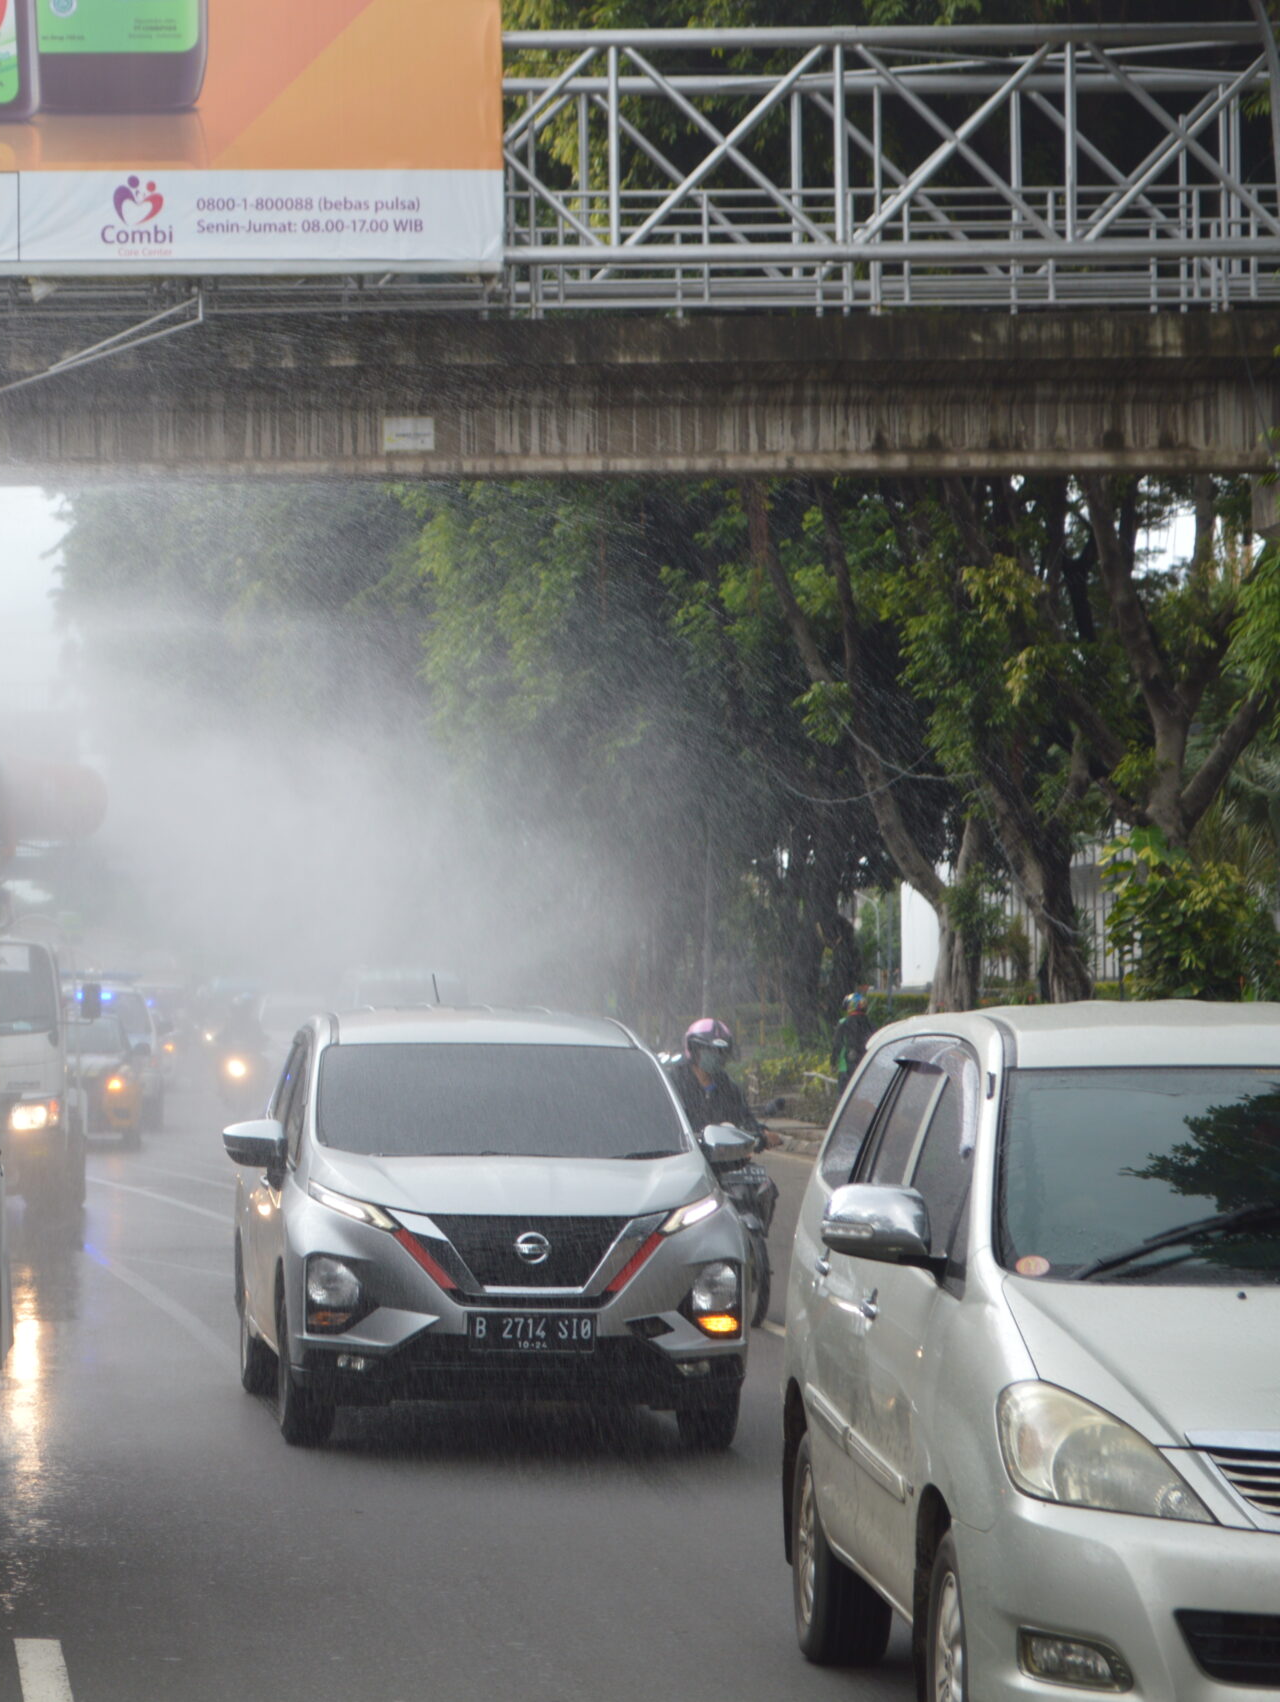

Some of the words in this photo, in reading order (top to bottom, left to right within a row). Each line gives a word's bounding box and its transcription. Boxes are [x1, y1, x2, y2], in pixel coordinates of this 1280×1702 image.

[196, 196, 313, 211] 0800-1-800088
[318, 196, 370, 213] (bebas
[374, 196, 420, 214] pulsa)
[100, 224, 174, 244] Combi
[196, 218, 298, 234] Senin-Jumat:
[301, 218, 389, 232] 08.00-17.00
[393, 218, 424, 232] WIB
[476, 1317, 486, 1339] B
[502, 1318, 546, 1340] 2714
